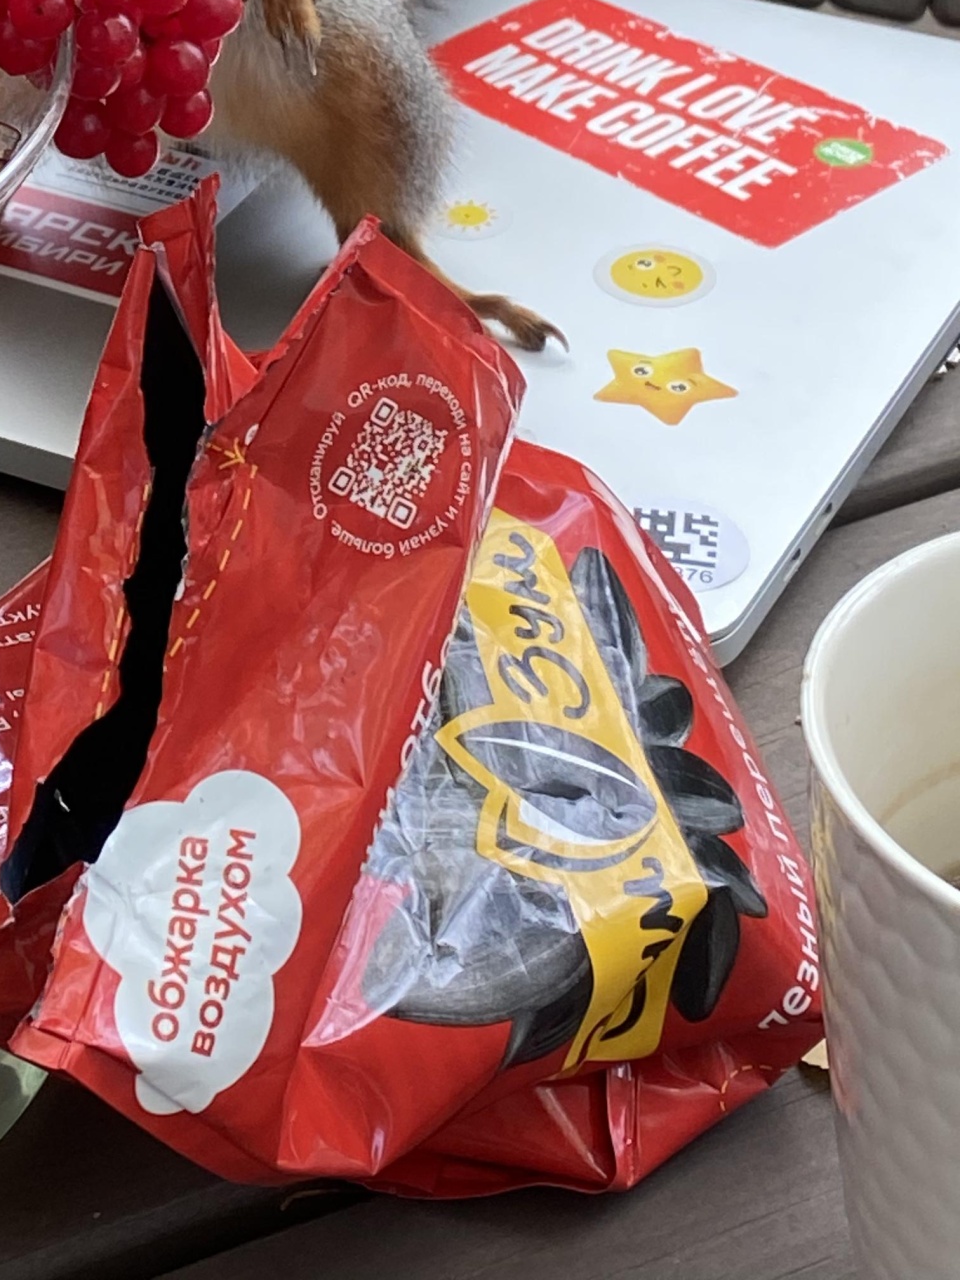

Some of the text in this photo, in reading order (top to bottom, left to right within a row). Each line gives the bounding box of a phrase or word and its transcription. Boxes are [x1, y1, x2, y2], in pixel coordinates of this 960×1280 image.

[521, 17, 820, 144] DRINK LOVE
[463, 44, 797, 201] MAKE COFFEE
[416, 373, 467, 430] переходи
[310, 411, 346, 520] Отсканируй
[454, 461, 472, 506] сайт
[458, 433, 472, 457] на
[399, 516, 449, 556] узнай
[445, 506, 458, 520] и
[147, 836, 210, 1042] обжарка
[190, 828, 257, 1057] воздухом
